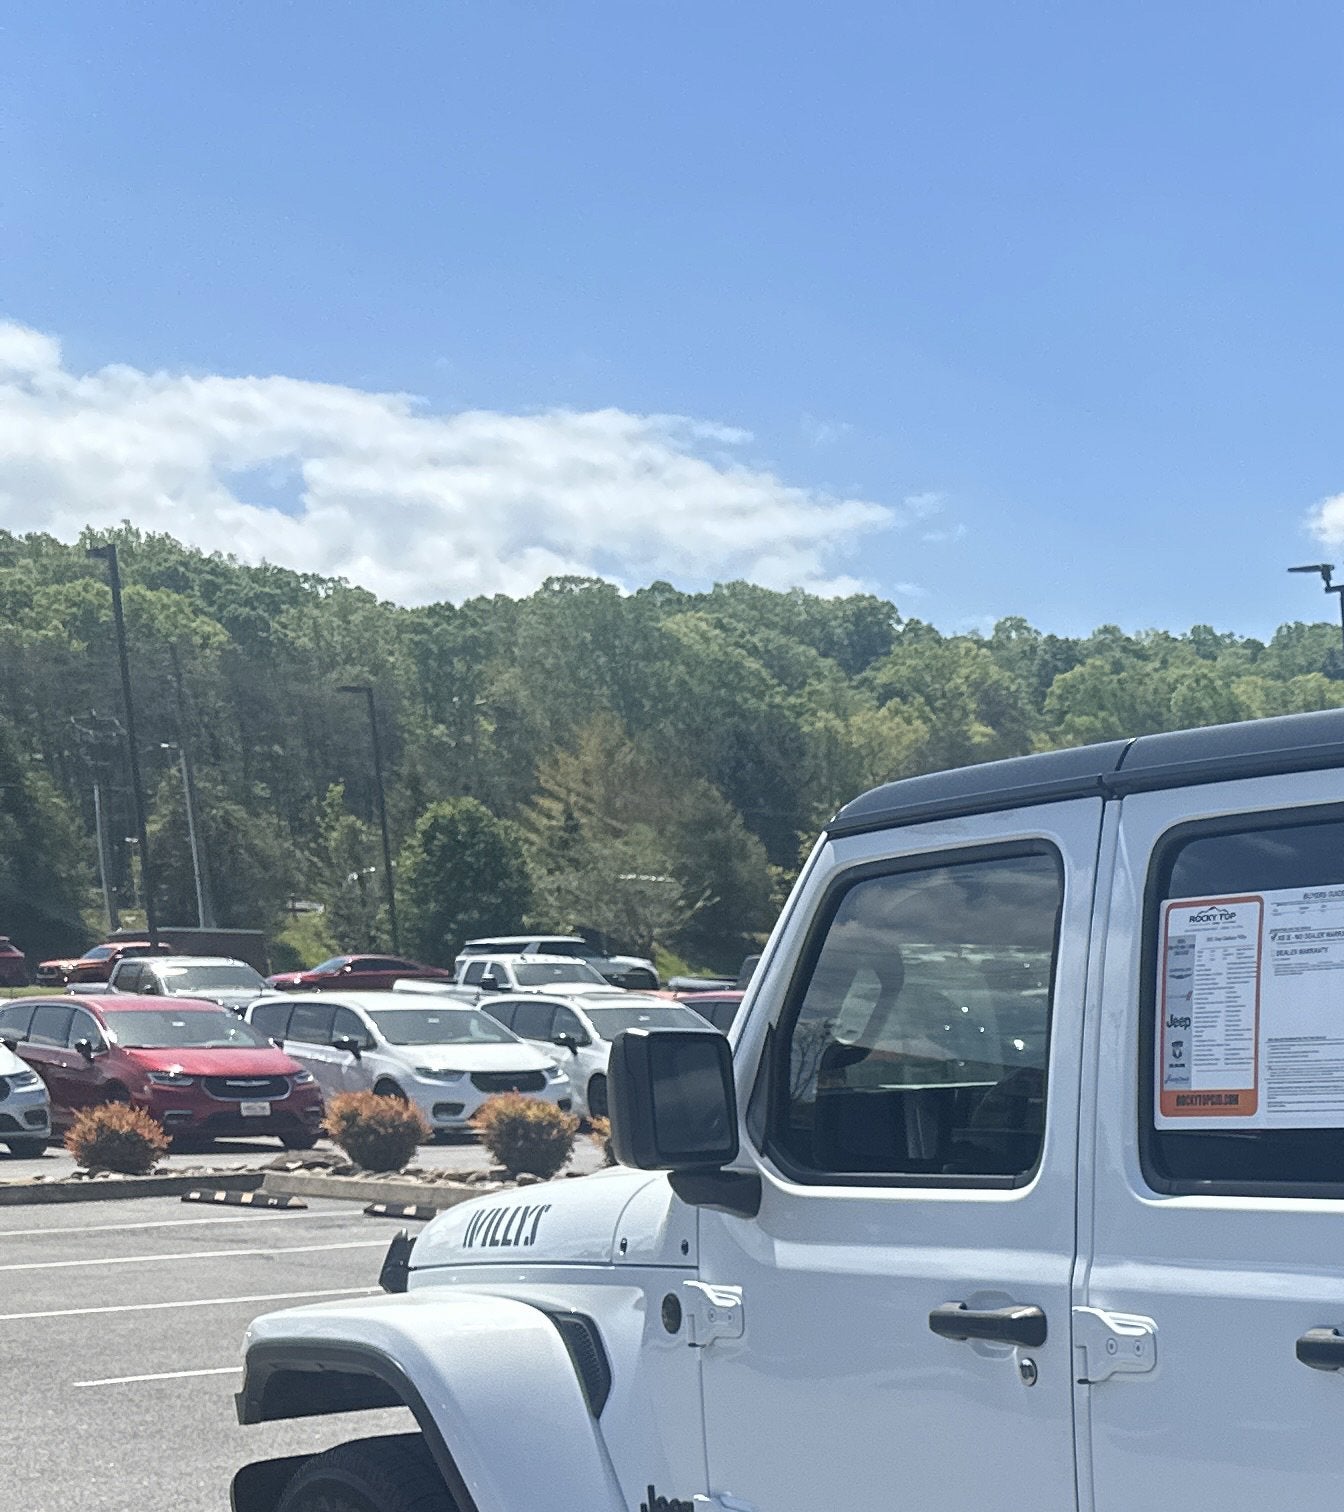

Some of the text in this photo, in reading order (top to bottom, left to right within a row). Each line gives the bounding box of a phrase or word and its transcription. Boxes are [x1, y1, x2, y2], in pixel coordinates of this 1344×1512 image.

[1189, 911, 1237, 923] ROCKY TOP
[1166, 1014, 1191, 1030] Jeep
[462, 1204, 552, 1248] WILLYS
